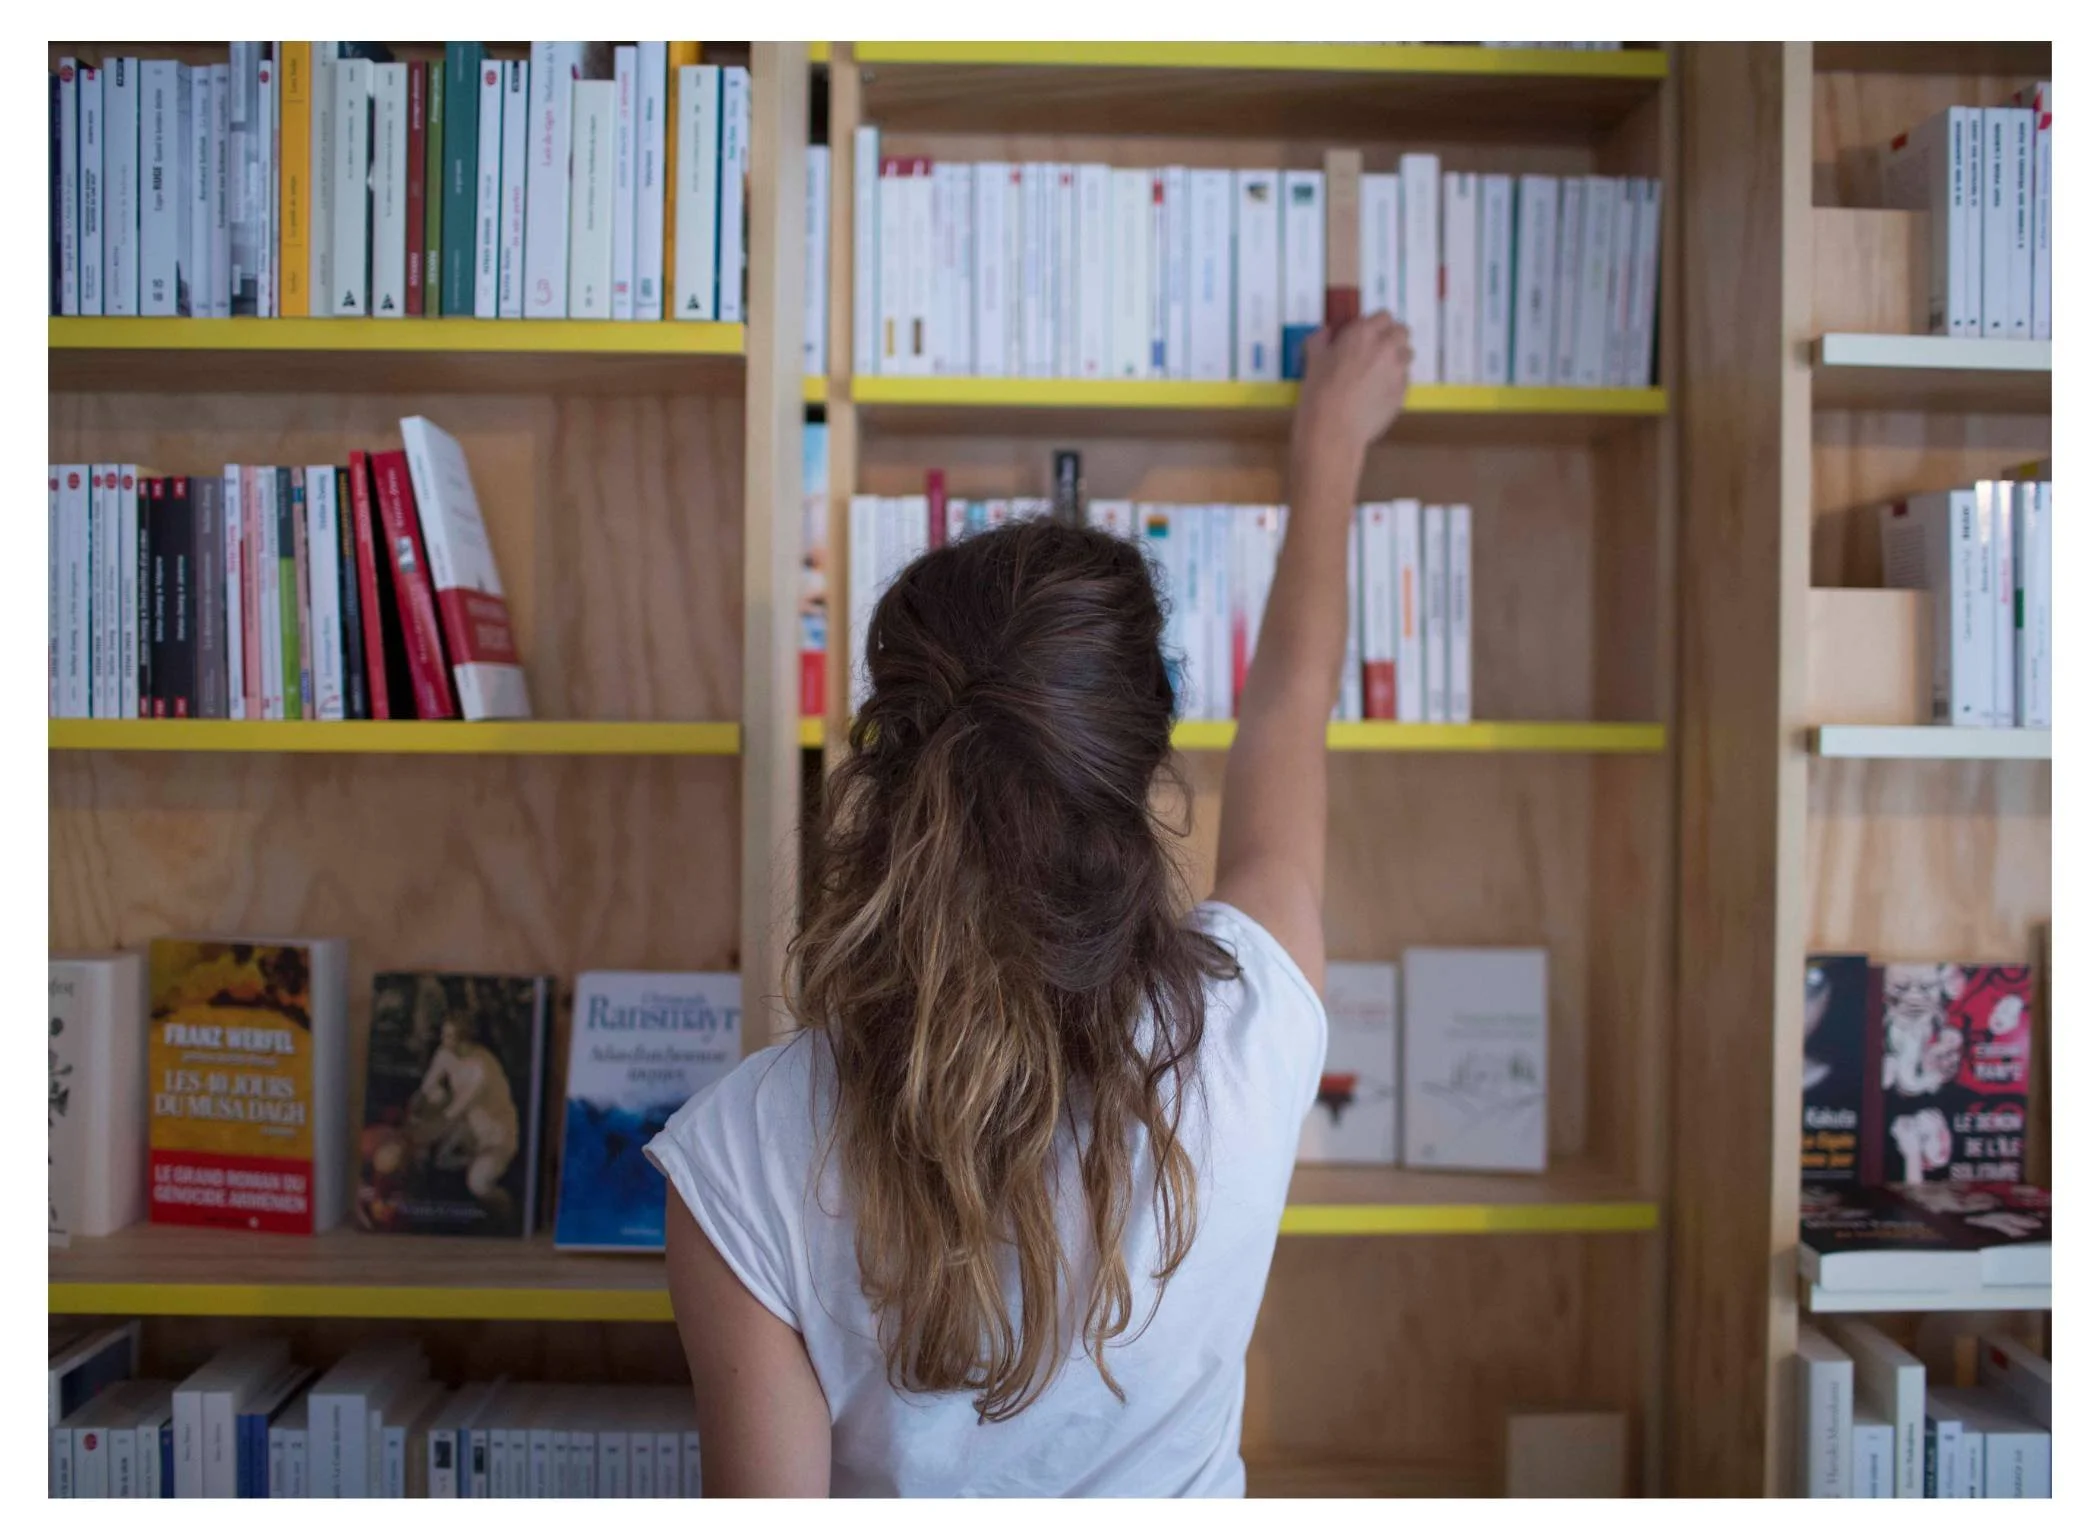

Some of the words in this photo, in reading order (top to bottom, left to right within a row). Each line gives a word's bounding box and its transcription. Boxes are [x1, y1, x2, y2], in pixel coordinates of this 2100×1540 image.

[153, 166, 163, 191] RUGE
[588, 994, 741, 1044] Ransmayr
[164, 1023, 223, 1049] FRANZ
[226, 1027, 295, 1054] WERFEL
[164, 1069, 200, 1092] LES
[206, 1070, 228, 1095] 40
[232, 1074, 295, 1098] JOURS
[156, 1092, 186, 1116] DU
[188, 1094, 244, 1120] MUSA
[249, 1097, 305, 1125] DAGH
[1953, 1112, 1973, 1132] LE
[154, 1163, 171, 1183] LE
[173, 1165, 225, 1186] GRAND
[227, 1169, 280, 1190] ROMAN
[282, 1173, 307, 1193] DU
